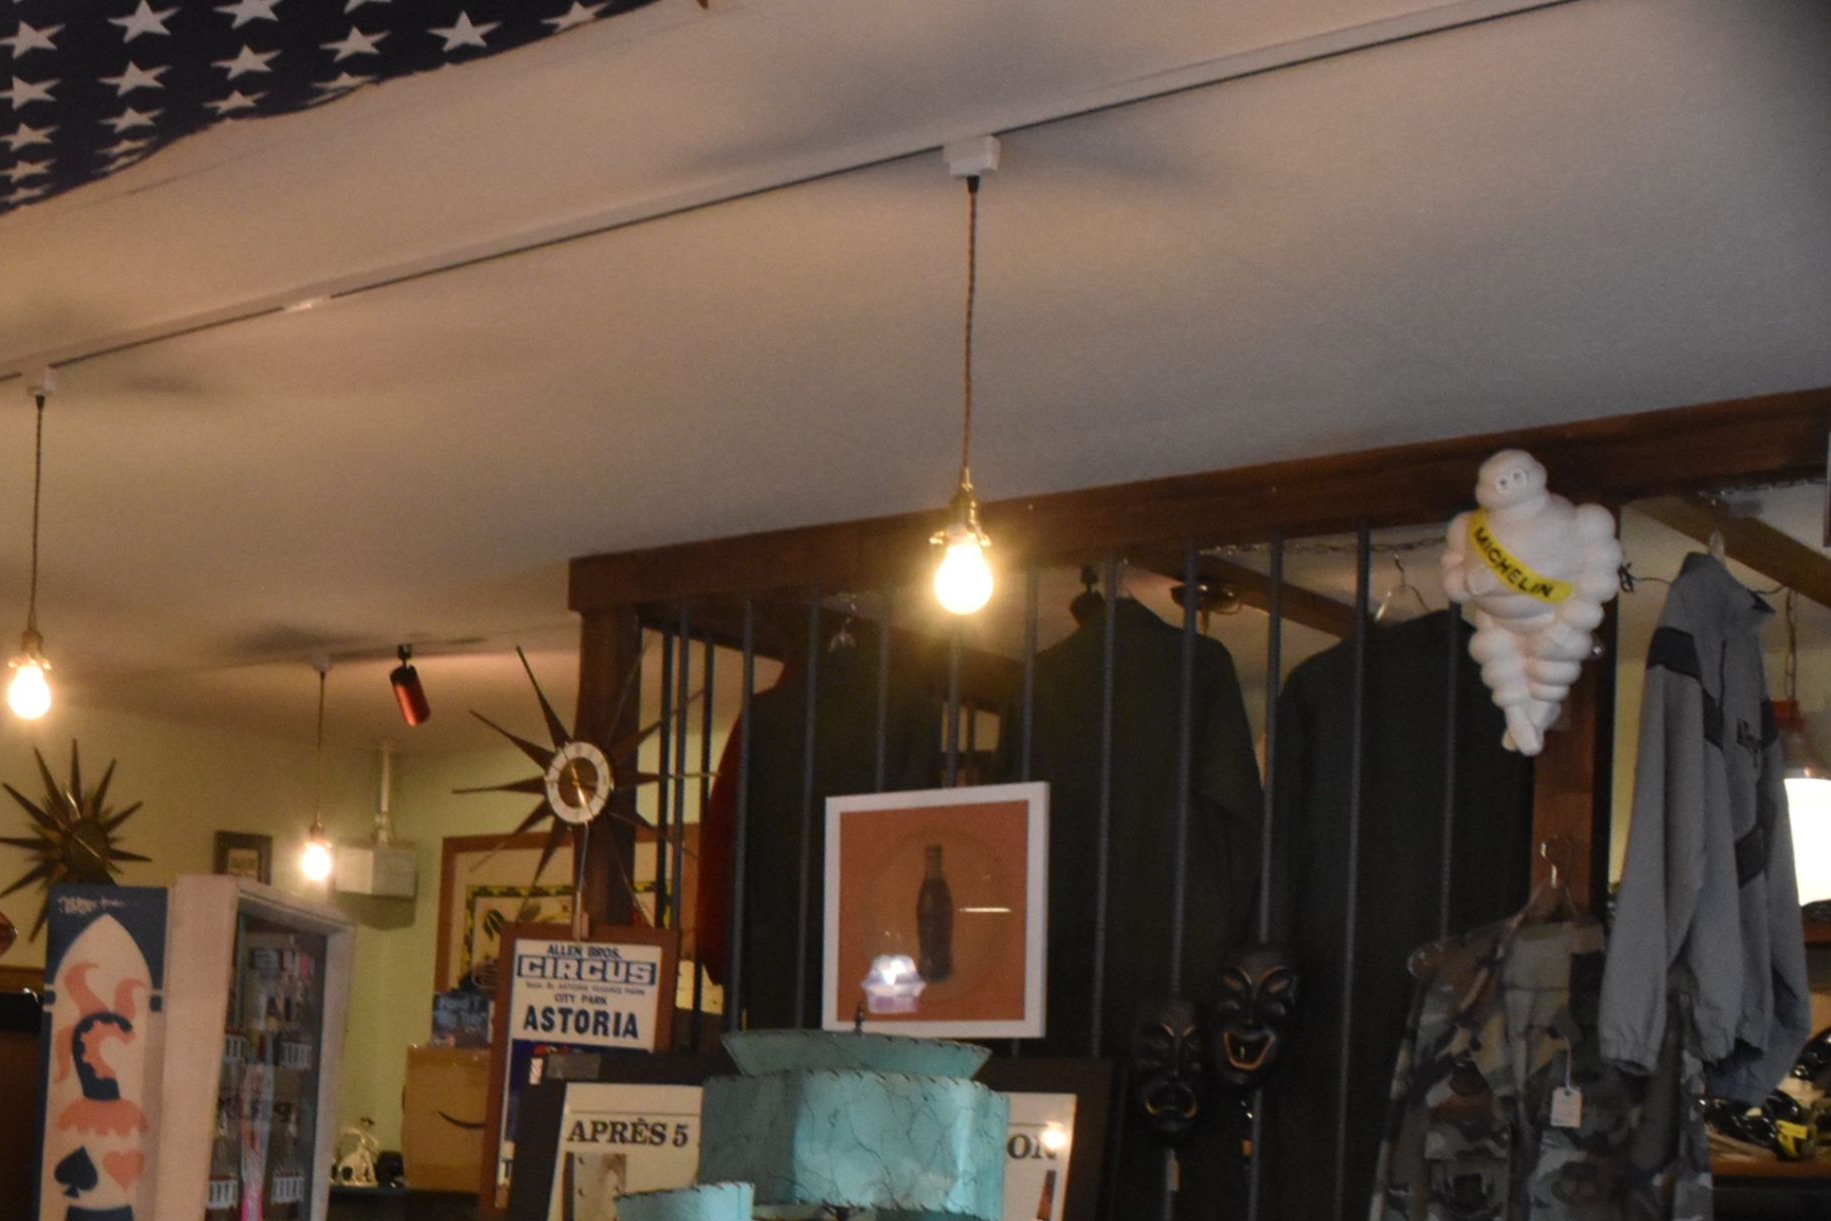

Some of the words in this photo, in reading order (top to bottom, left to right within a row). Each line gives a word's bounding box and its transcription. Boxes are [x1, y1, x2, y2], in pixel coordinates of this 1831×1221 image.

[1474, 526, 1554, 597] MICHELIN
[518, 955, 654, 985] CIRCUS
[523, 1003, 640, 1040] ASTORIA
[672, 1124, 689, 1147] 5
